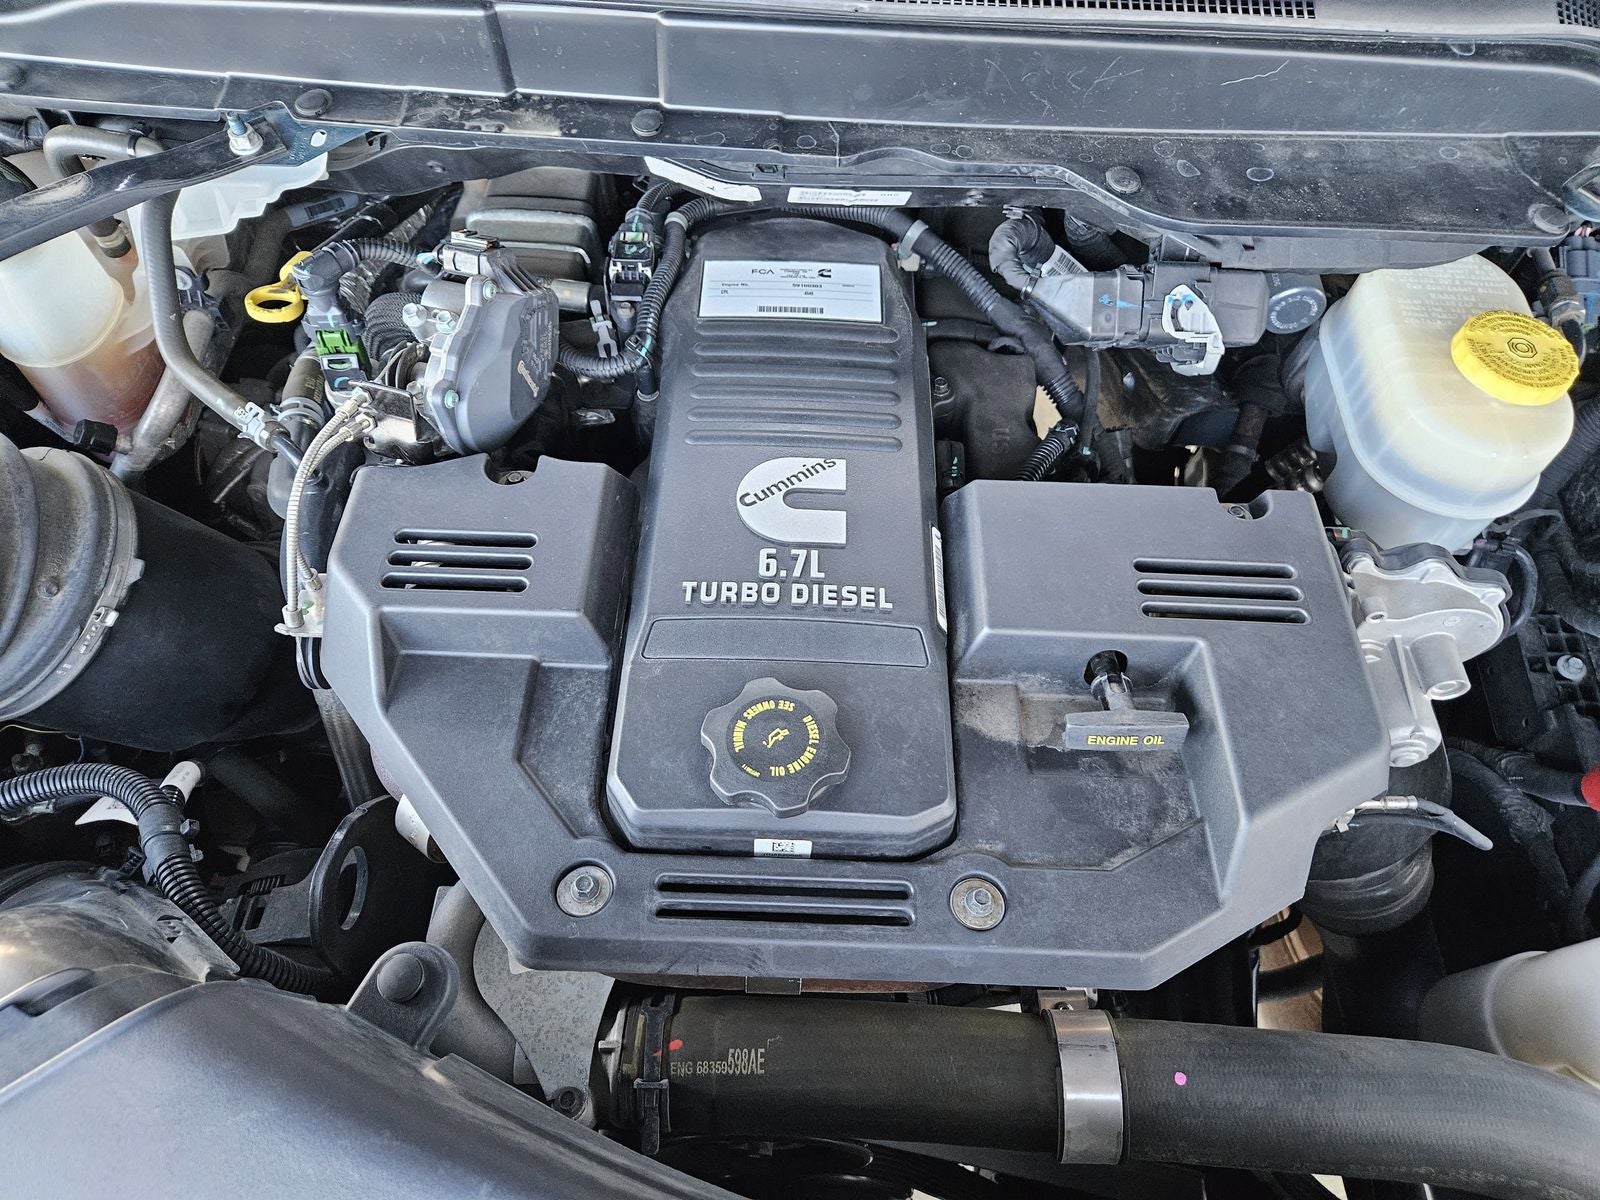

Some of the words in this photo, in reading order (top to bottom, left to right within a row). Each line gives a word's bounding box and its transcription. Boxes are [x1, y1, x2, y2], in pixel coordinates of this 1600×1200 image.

[739, 457, 837, 507] Cummins
[758, 547, 826, 579] 6.7L
[682, 581, 781, 606] TURBO
[791, 583, 894, 612] DIESEL
[777, 700, 795, 712] SEE
[802, 714, 820, 745] DIESEL
[1087, 735, 1139, 746] ENGINE
[1143, 735, 1165, 745] OIL
[769, 765, 786, 777] OIL
[786, 746, 817, 774] ENGINE
[670, 1061, 693, 1075] ENG
